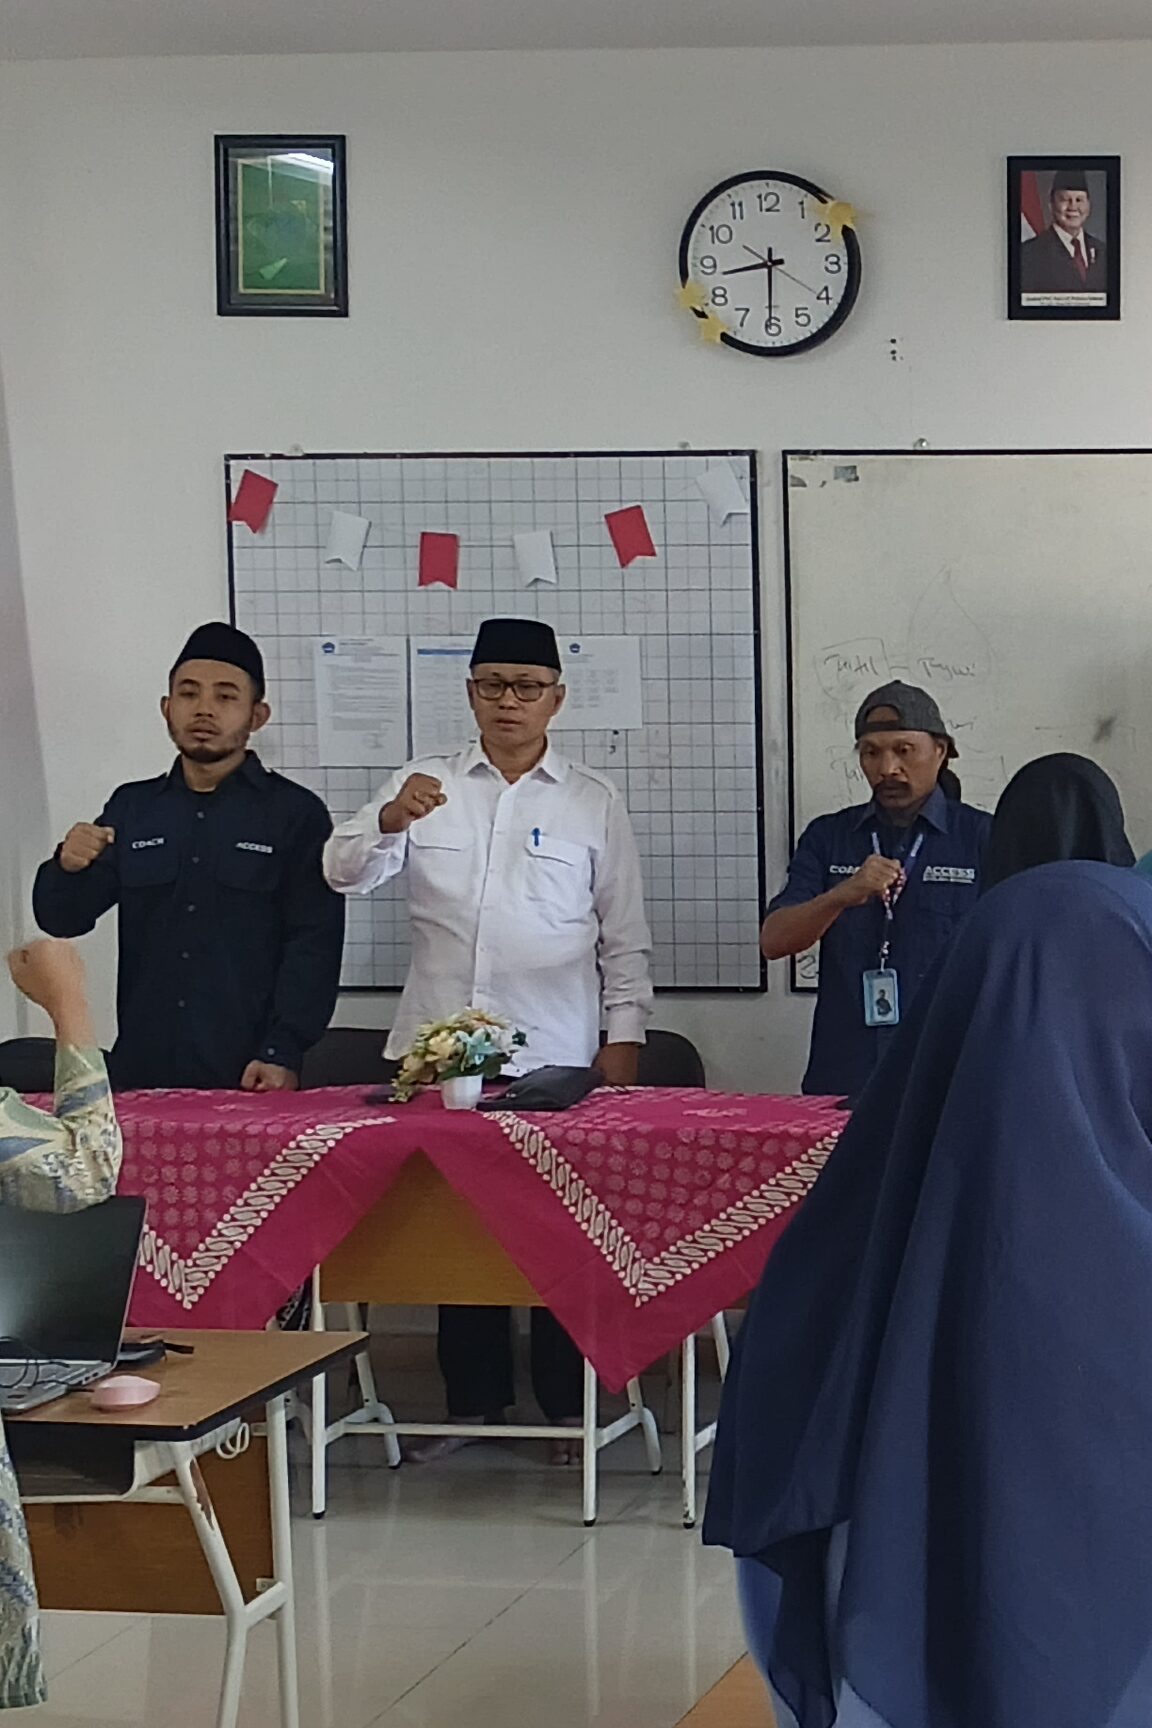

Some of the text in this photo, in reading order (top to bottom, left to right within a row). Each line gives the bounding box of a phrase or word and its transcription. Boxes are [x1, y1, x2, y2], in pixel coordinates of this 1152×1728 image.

[730, 201, 744, 220] 11
[757, 192, 780, 212] 12
[799, 200, 806, 219] 1
[709, 224, 733, 244] 10
[814, 222, 831, 243] 2
[700, 255, 717, 275] 9
[824, 253, 842, 274] 3
[711, 286, 728, 307] 8
[816, 285, 832, 305] 4
[735, 307, 750, 328] 7
[764, 316, 782, 337] 6
[794, 307, 811, 327] 5
[923, 865, 976, 879] ACCESS
